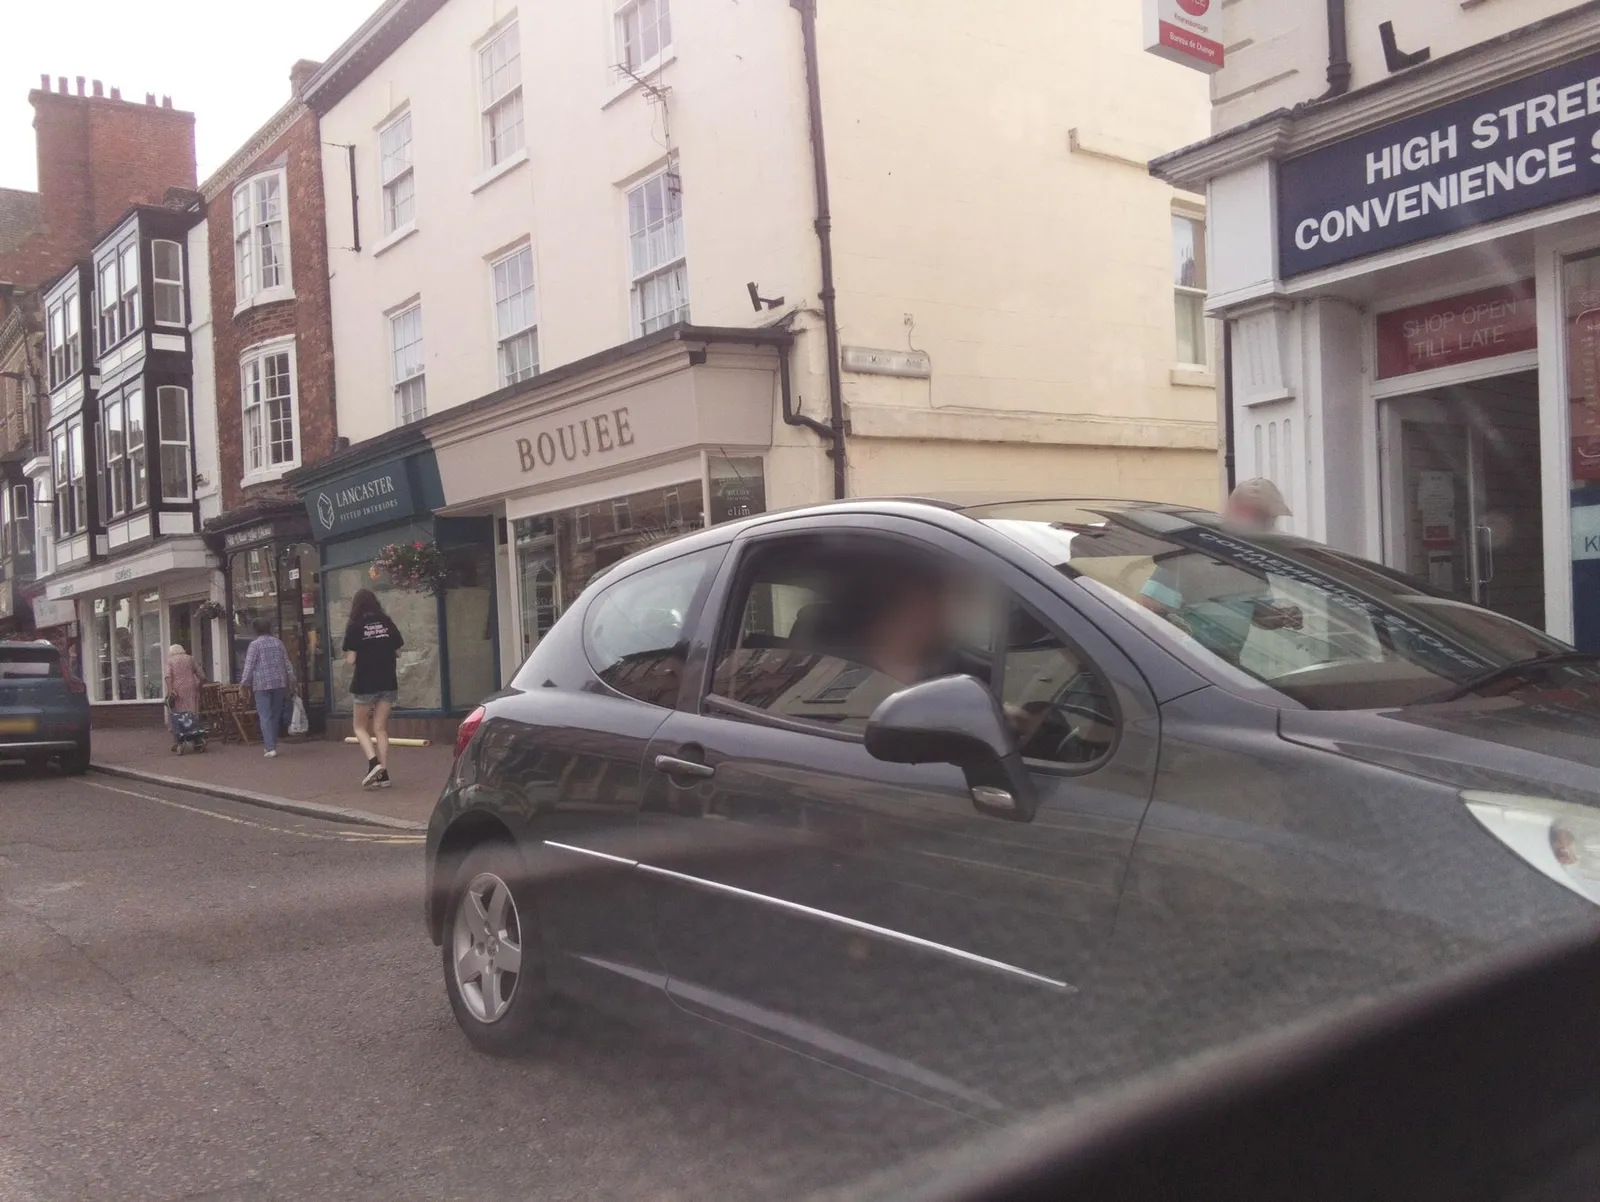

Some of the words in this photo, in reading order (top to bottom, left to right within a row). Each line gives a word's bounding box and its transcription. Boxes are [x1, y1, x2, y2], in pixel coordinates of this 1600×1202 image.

[1170, 31, 1189, 46] Bureau
[1196, 42, 1215, 57] Change
[1366, 125, 1457, 185] HIGH
[1295, 137, 1576, 250] CONVENIENCE
[1403, 311, 1455, 338] SHOP
[1461, 298, 1516, 324] OPEN
[1414, 338, 1452, 359] TILL
[1458, 325, 1505, 350] LATE
[515, 407, 634, 472] BOUJEE
[335, 475, 394, 507] LANCASTER
[340, 509, 361, 522] FITTED
[363, 498, 398, 516] INTERIORS
